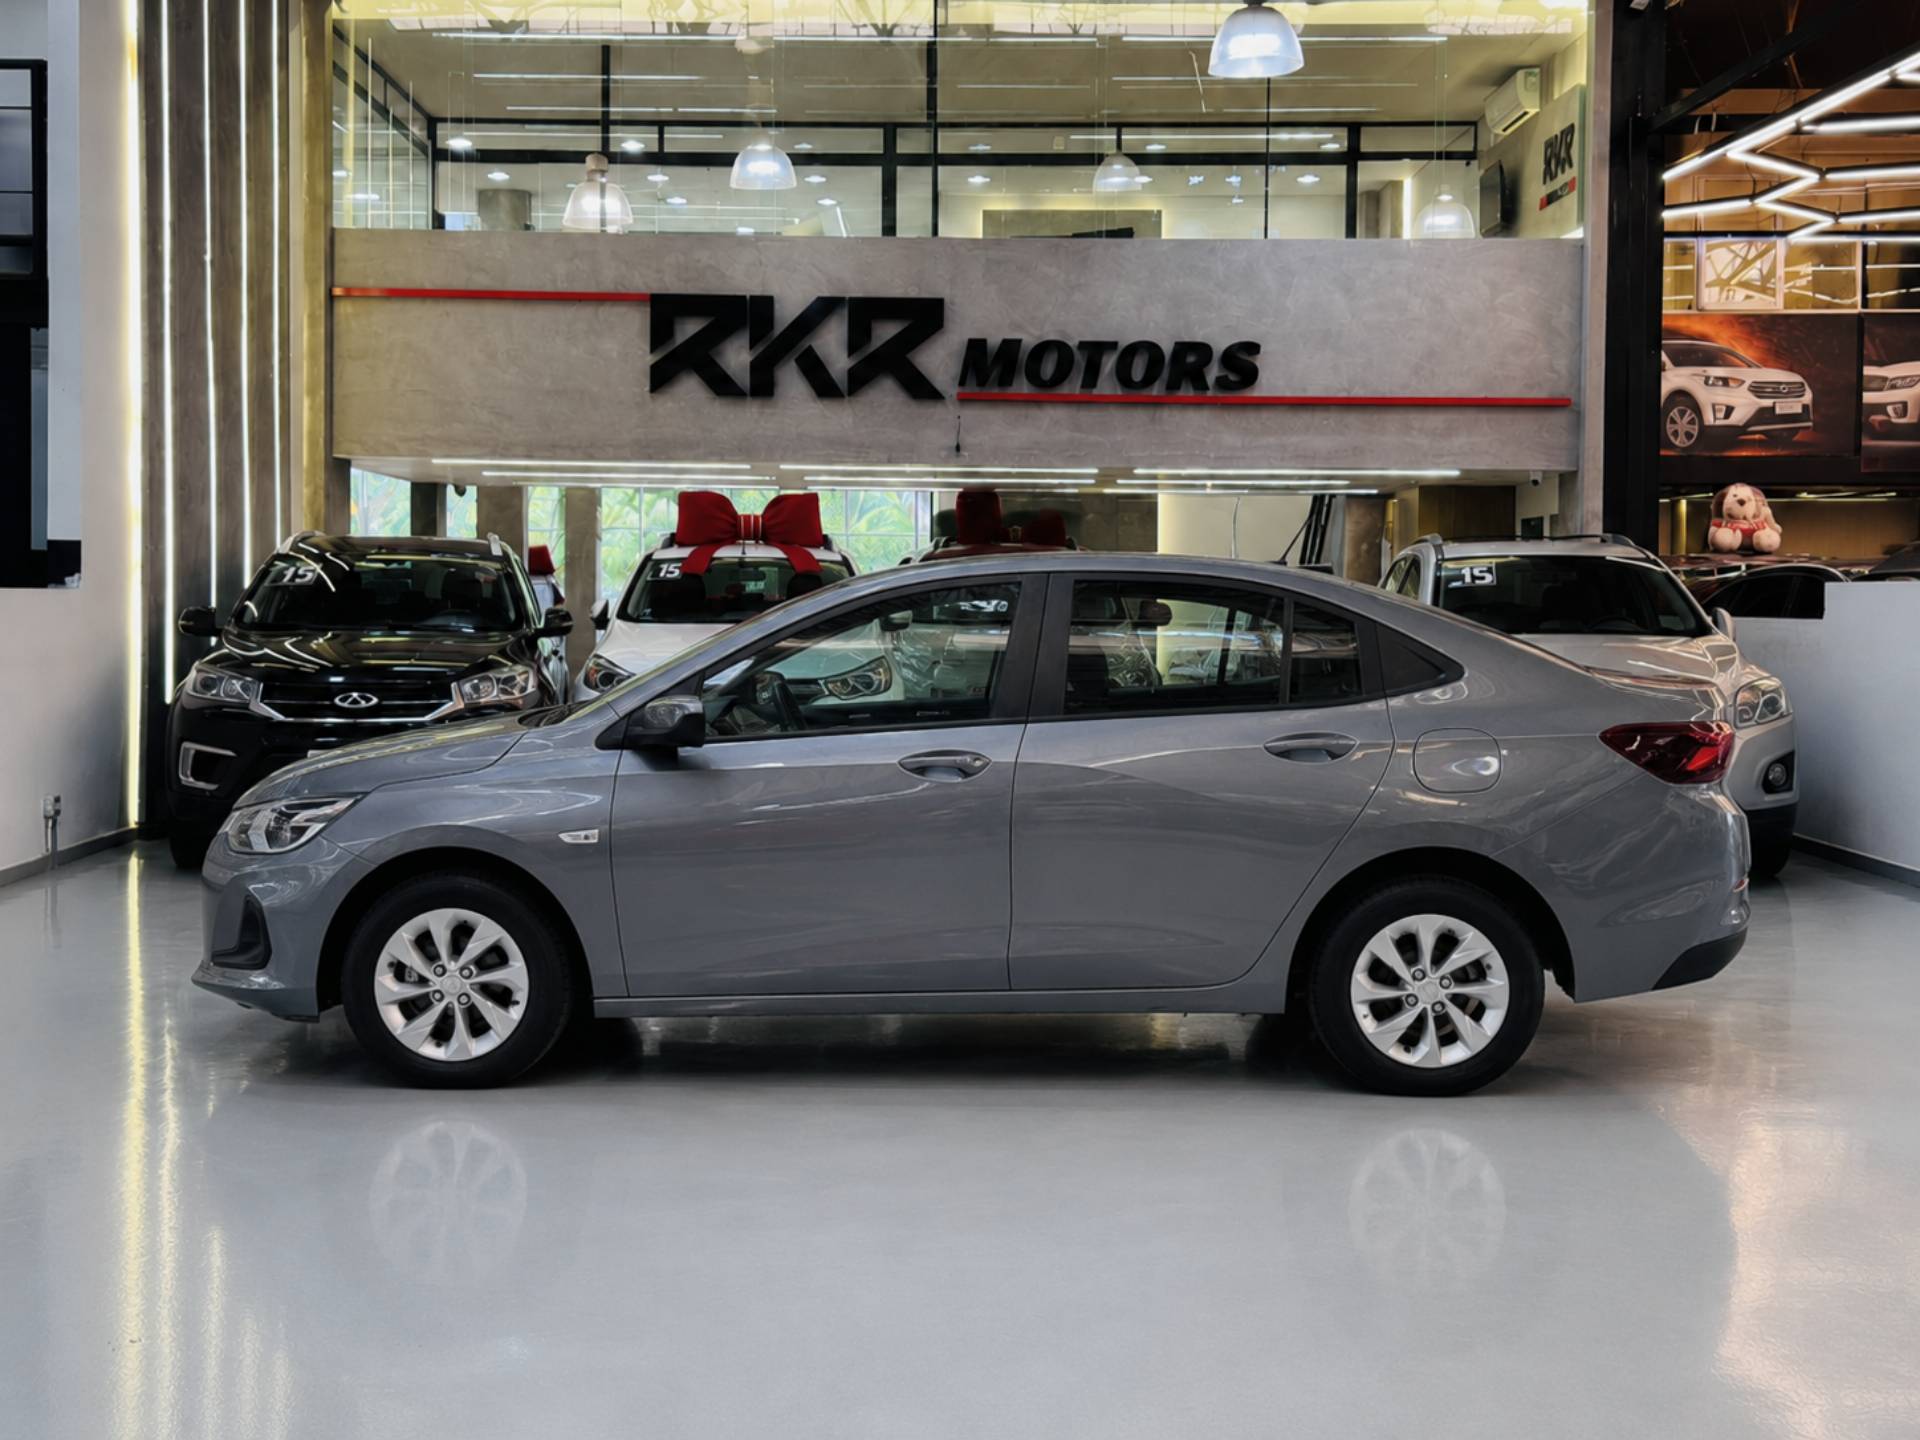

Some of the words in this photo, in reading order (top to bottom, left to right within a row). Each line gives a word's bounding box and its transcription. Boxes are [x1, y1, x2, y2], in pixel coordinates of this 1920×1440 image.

[650, 293, 945, 400] RKR
[958, 338, 1261, 391] MOTORS
[283, 566, 315, 583] 15
[659, 562, 682, 578] 15
[1461, 566, 1493, 585] 15
